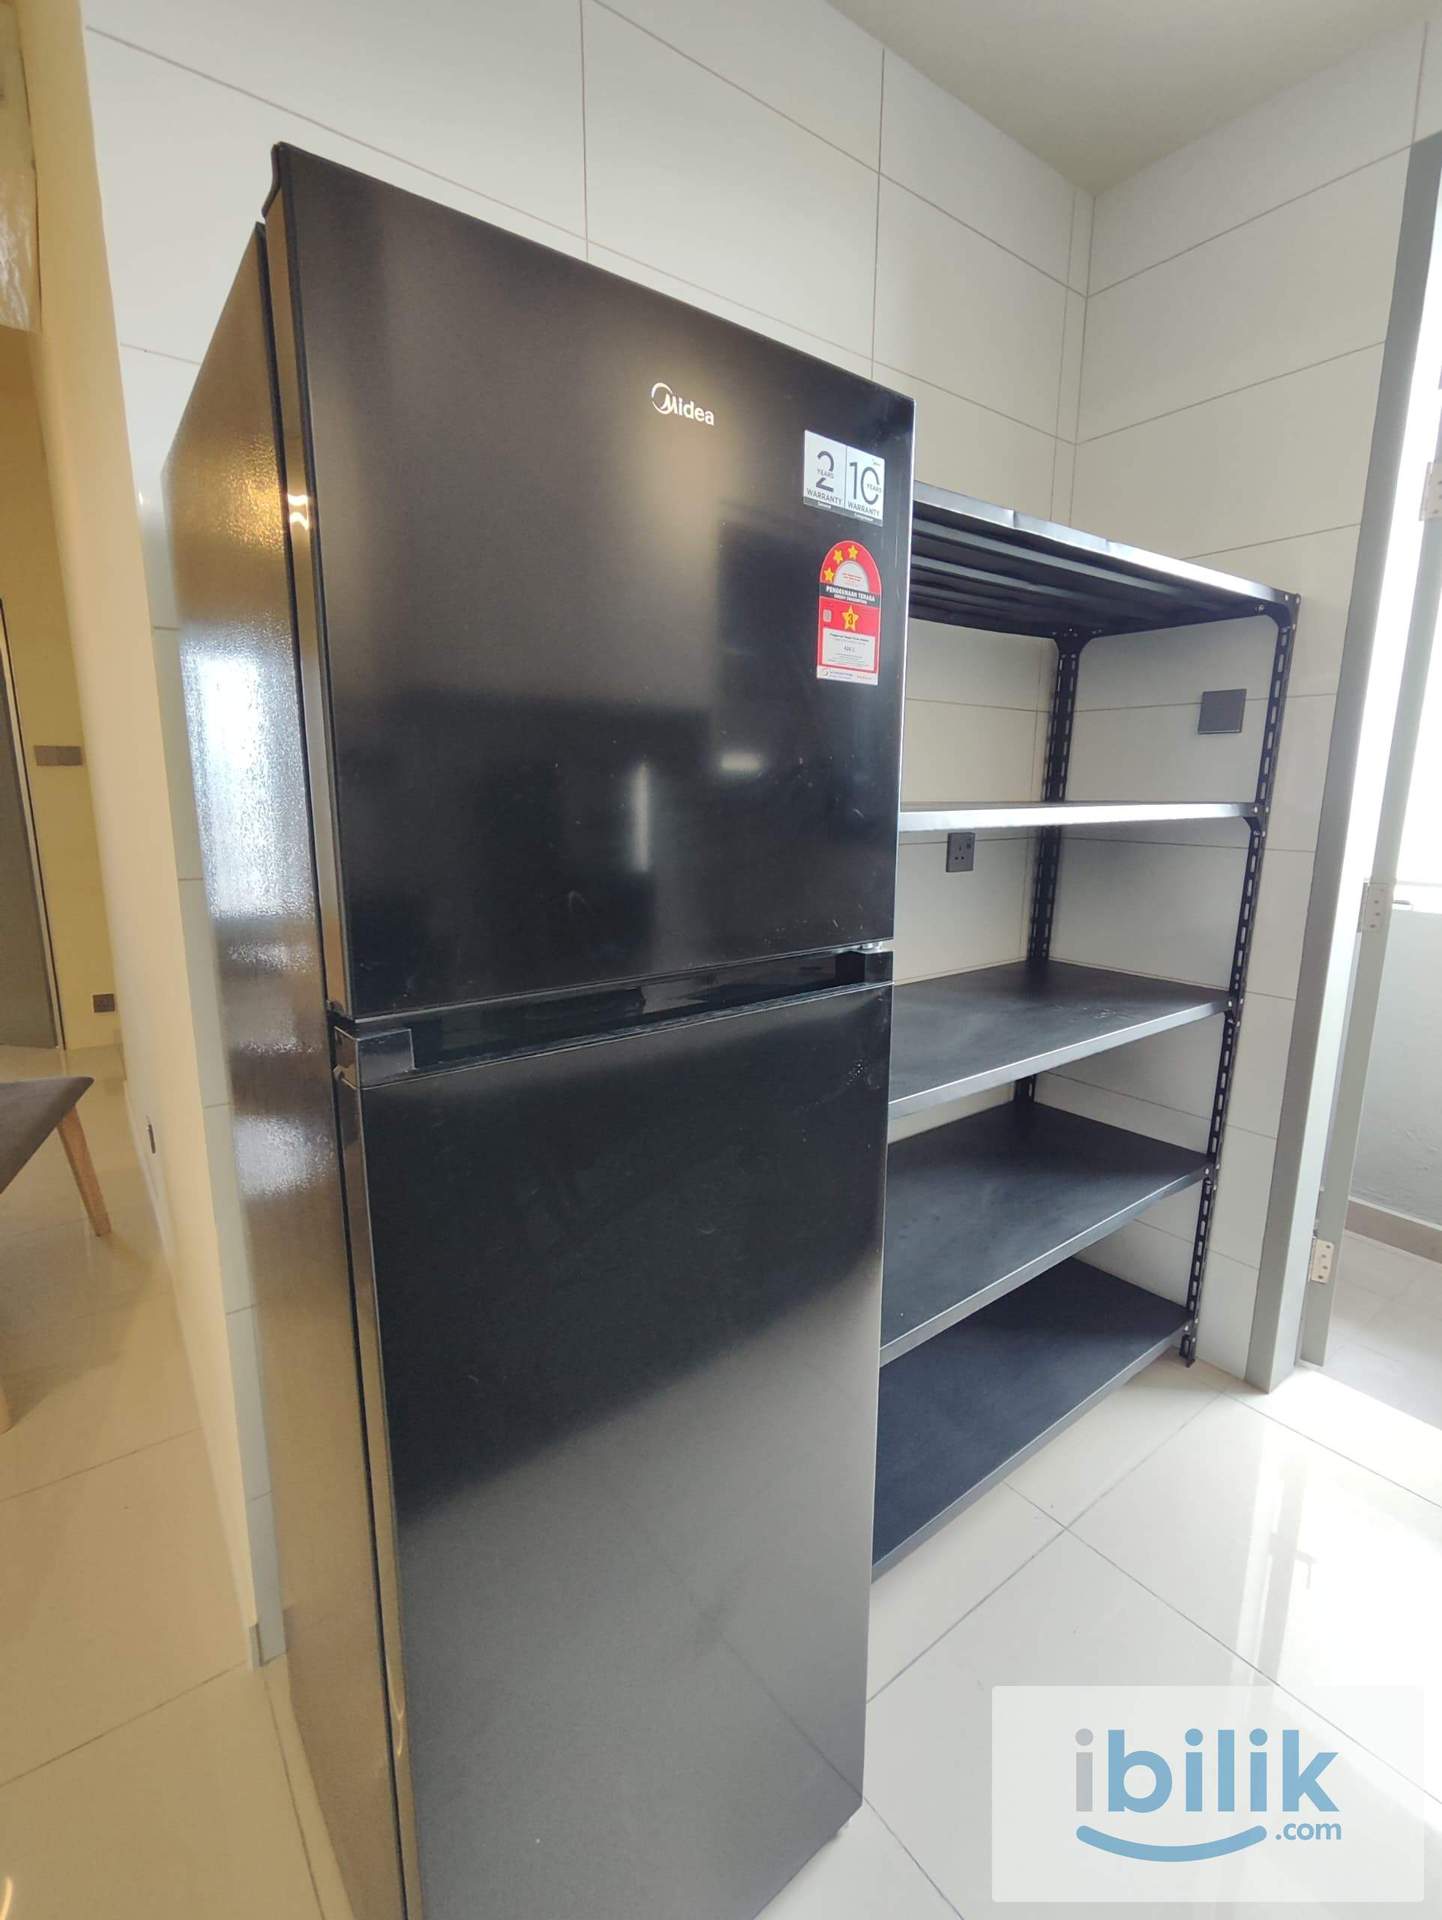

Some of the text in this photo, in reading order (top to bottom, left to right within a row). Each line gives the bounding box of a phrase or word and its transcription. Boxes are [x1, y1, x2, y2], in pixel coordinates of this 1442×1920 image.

[651, 382, 714, 426] Midea
[815, 450, 834, 492] 2
[817, 468, 834, 479] YEARS
[849, 462, 880, 505] 10
[866, 483, 882, 493] YEARS
[806, 487, 842, 505] WARRANTY
[847, 501, 880, 517] WARRANTY
[847, 613, 855, 625] 3
